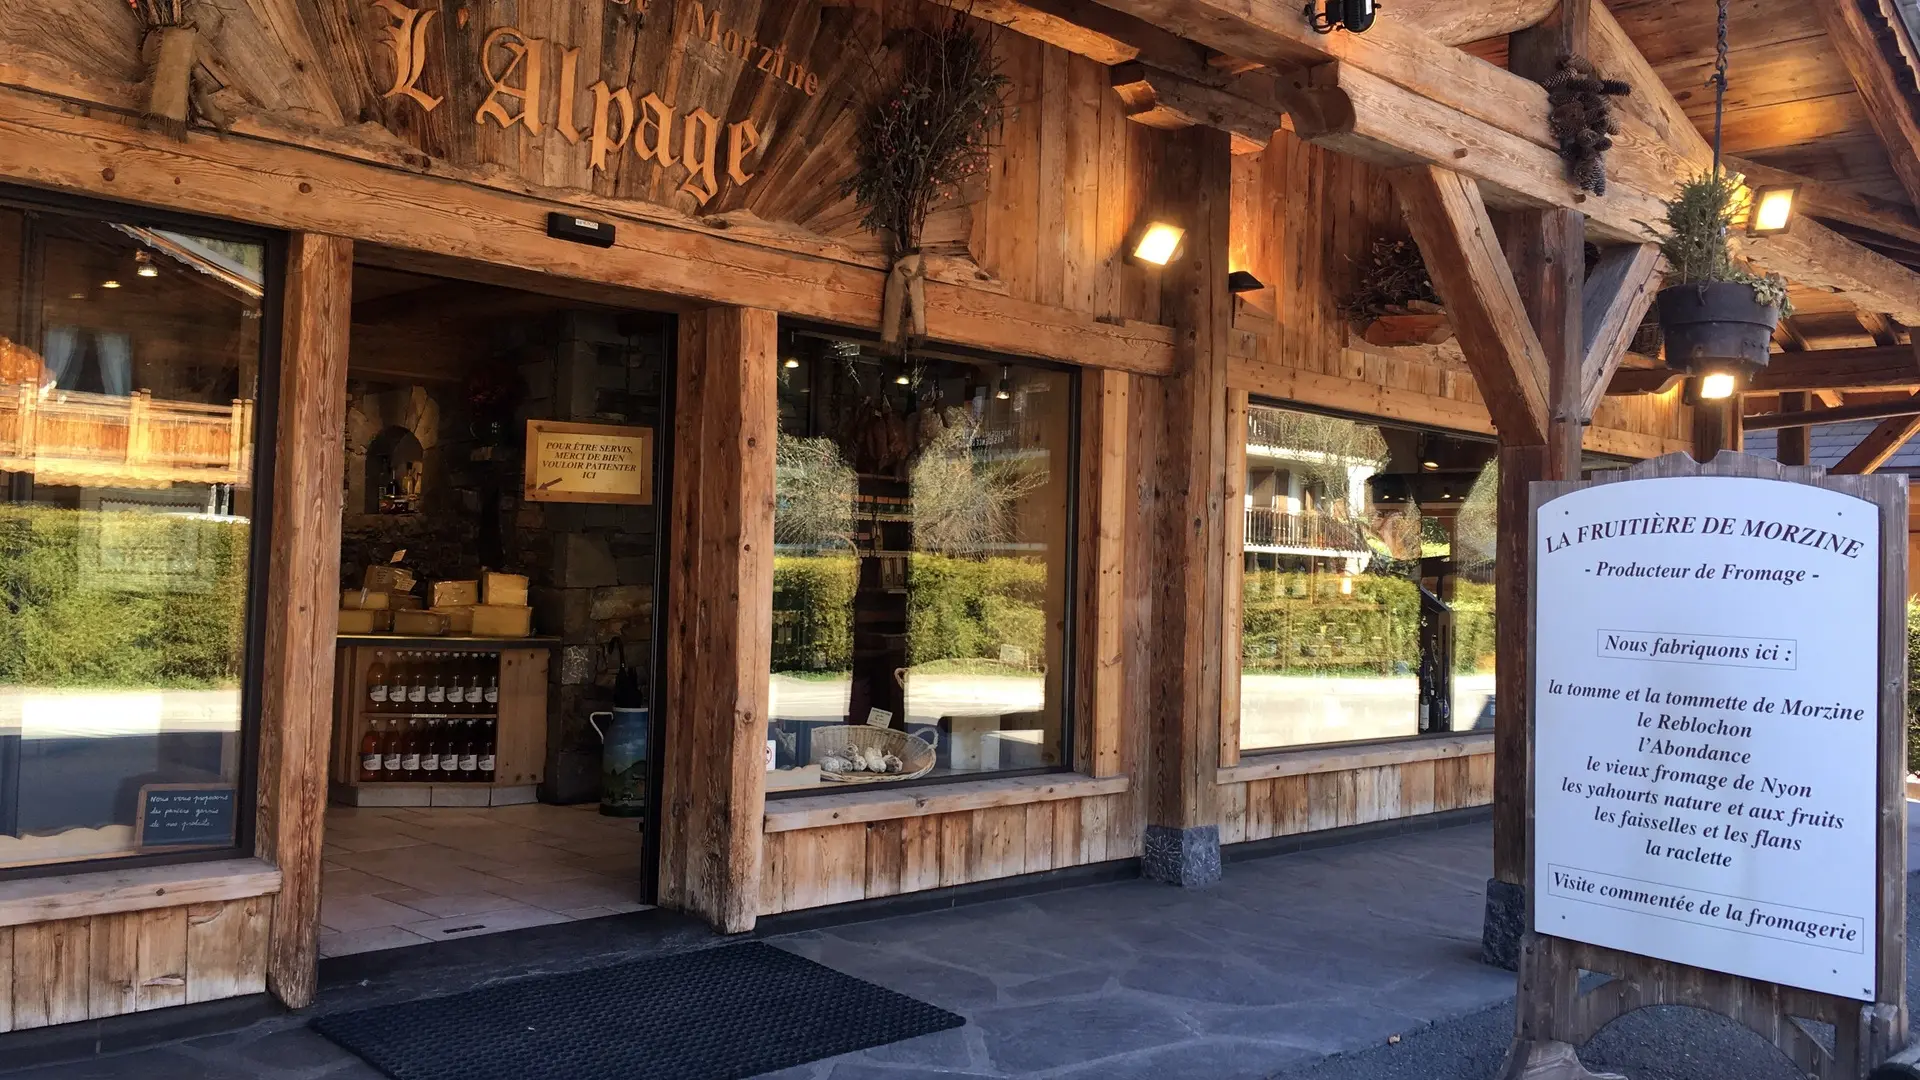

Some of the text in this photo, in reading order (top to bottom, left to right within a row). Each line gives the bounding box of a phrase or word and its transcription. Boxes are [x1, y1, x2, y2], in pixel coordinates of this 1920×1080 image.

[688, 2, 818, 97] Morzine
[546, 442, 572, 450] POUR
[599, 444, 633, 454] SERVIS,
[554, 452, 586, 460] MERCI
[602, 454, 625, 462] BIEN
[542, 460, 636, 472] VOULOIR PATIENTER
[1546, 512, 1864, 558] LA FRUITIÈRE DE MORZINE
[1596, 562, 1691, 578] Producteur
[1695, 563, 1715, 579] de
[1721, 564, 1806, 585] Fromage
[1605, 635, 1647, 652] Nous
[1650, 637, 1750, 660] fabriquons
[1756, 644, 1779, 660] ici
[1549, 679, 1864, 721] la tomme et la tommette de Morzine
[1638, 712, 1751, 738] le Reblochon
[1639, 737, 1751, 764] l'Abondance
[1587, 756, 1811, 798] le vieux fromage de Nyon
[1562, 777, 1844, 829] les yahourts nature et aux fruits
[1595, 806, 1801, 850] les faisselles et les flans
[1646, 839, 1732, 867] la raclette
[1555, 871, 1856, 942] Visite commentée de la fromagerie
